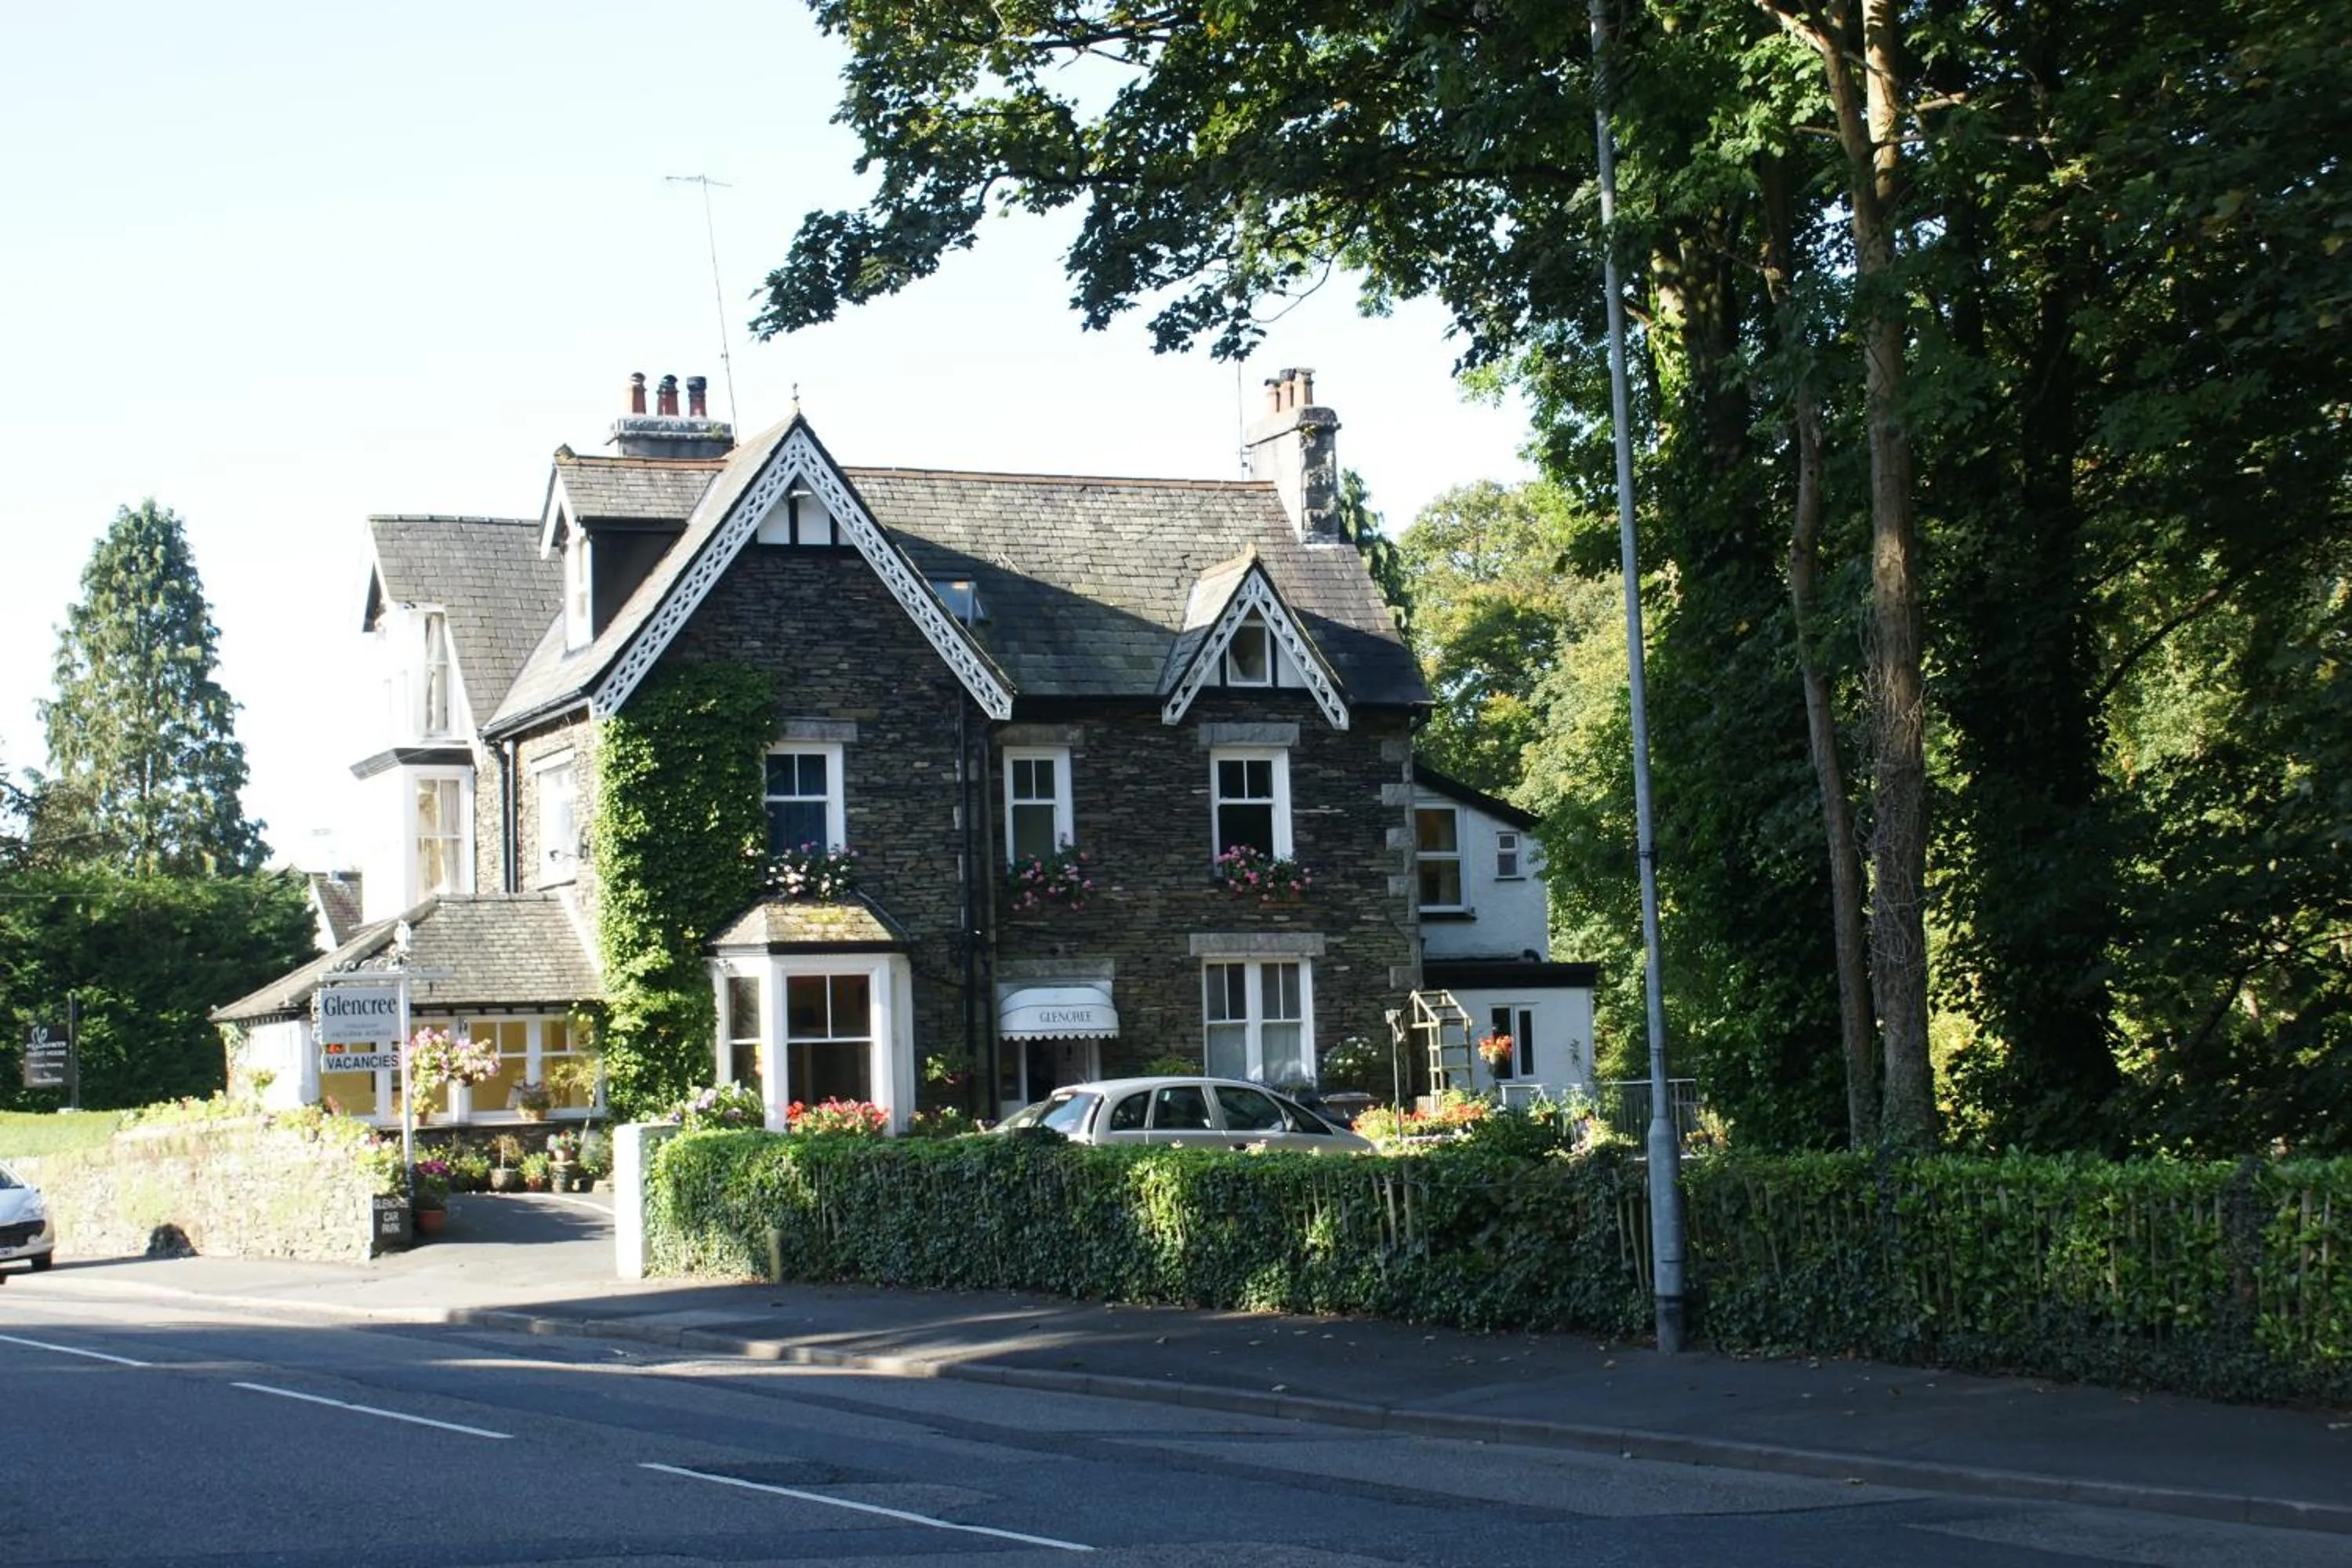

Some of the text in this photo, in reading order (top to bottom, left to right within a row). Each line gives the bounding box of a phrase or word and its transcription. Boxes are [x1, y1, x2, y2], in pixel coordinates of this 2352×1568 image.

[324, 996, 397, 1016] Glencree
[326, 1055, 399, 1069] VACANCIES
[383, 1211, 399, 1222] CAR
